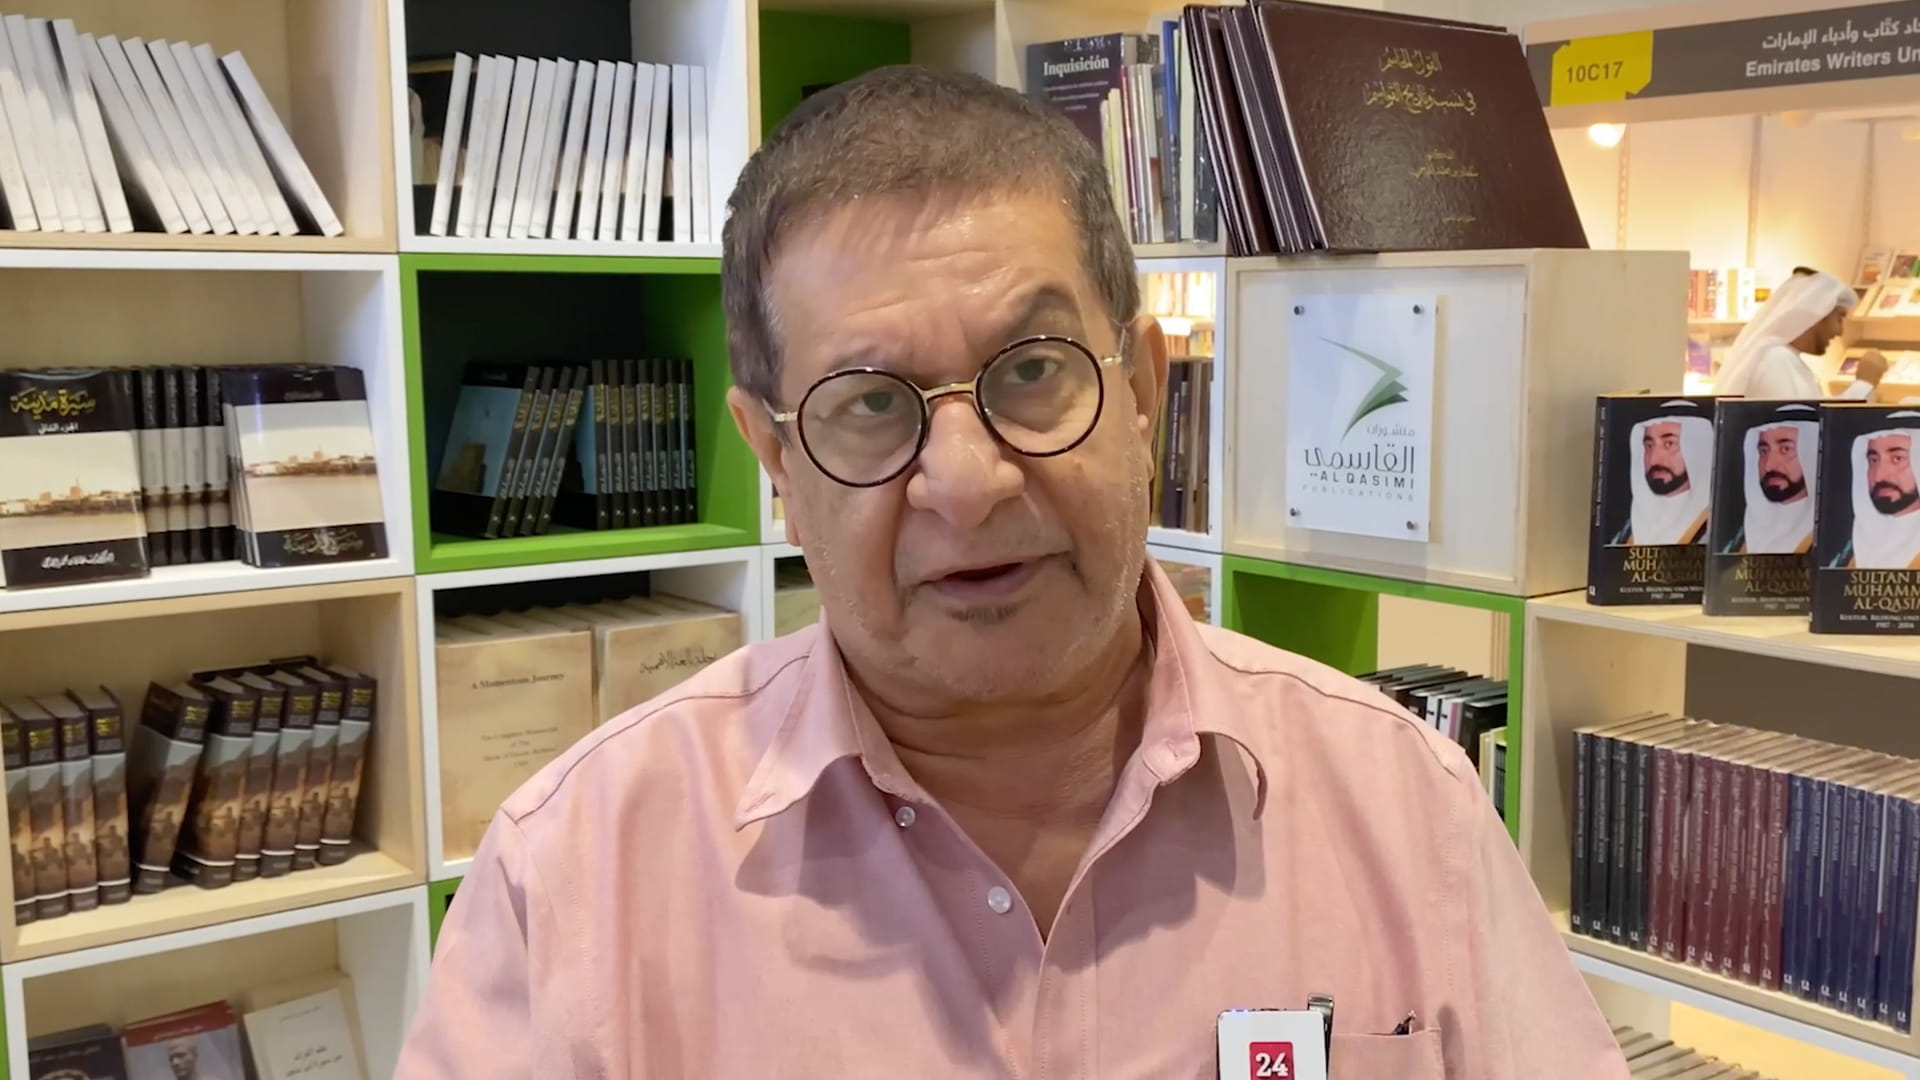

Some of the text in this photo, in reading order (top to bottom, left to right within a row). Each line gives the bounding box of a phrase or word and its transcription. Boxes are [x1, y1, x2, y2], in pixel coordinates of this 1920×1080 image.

[1762, 28, 1818, 50] الإمارات
[1821, 20, 1859, 46] وأدباء
[1043, 54, 1110, 78] Inquisición
[1566, 61, 1624, 84] 10C17
[1745, 57, 1822, 77] Emirates
[1826, 50, 1892, 70] Writers
[10, 387, 97, 420] سيرة مدينة
[1304, 443, 1415, 478] القاسمي
[1851, 571, 1910, 584] SULTAN
[1255, 1052, 1289, 1077] 24
